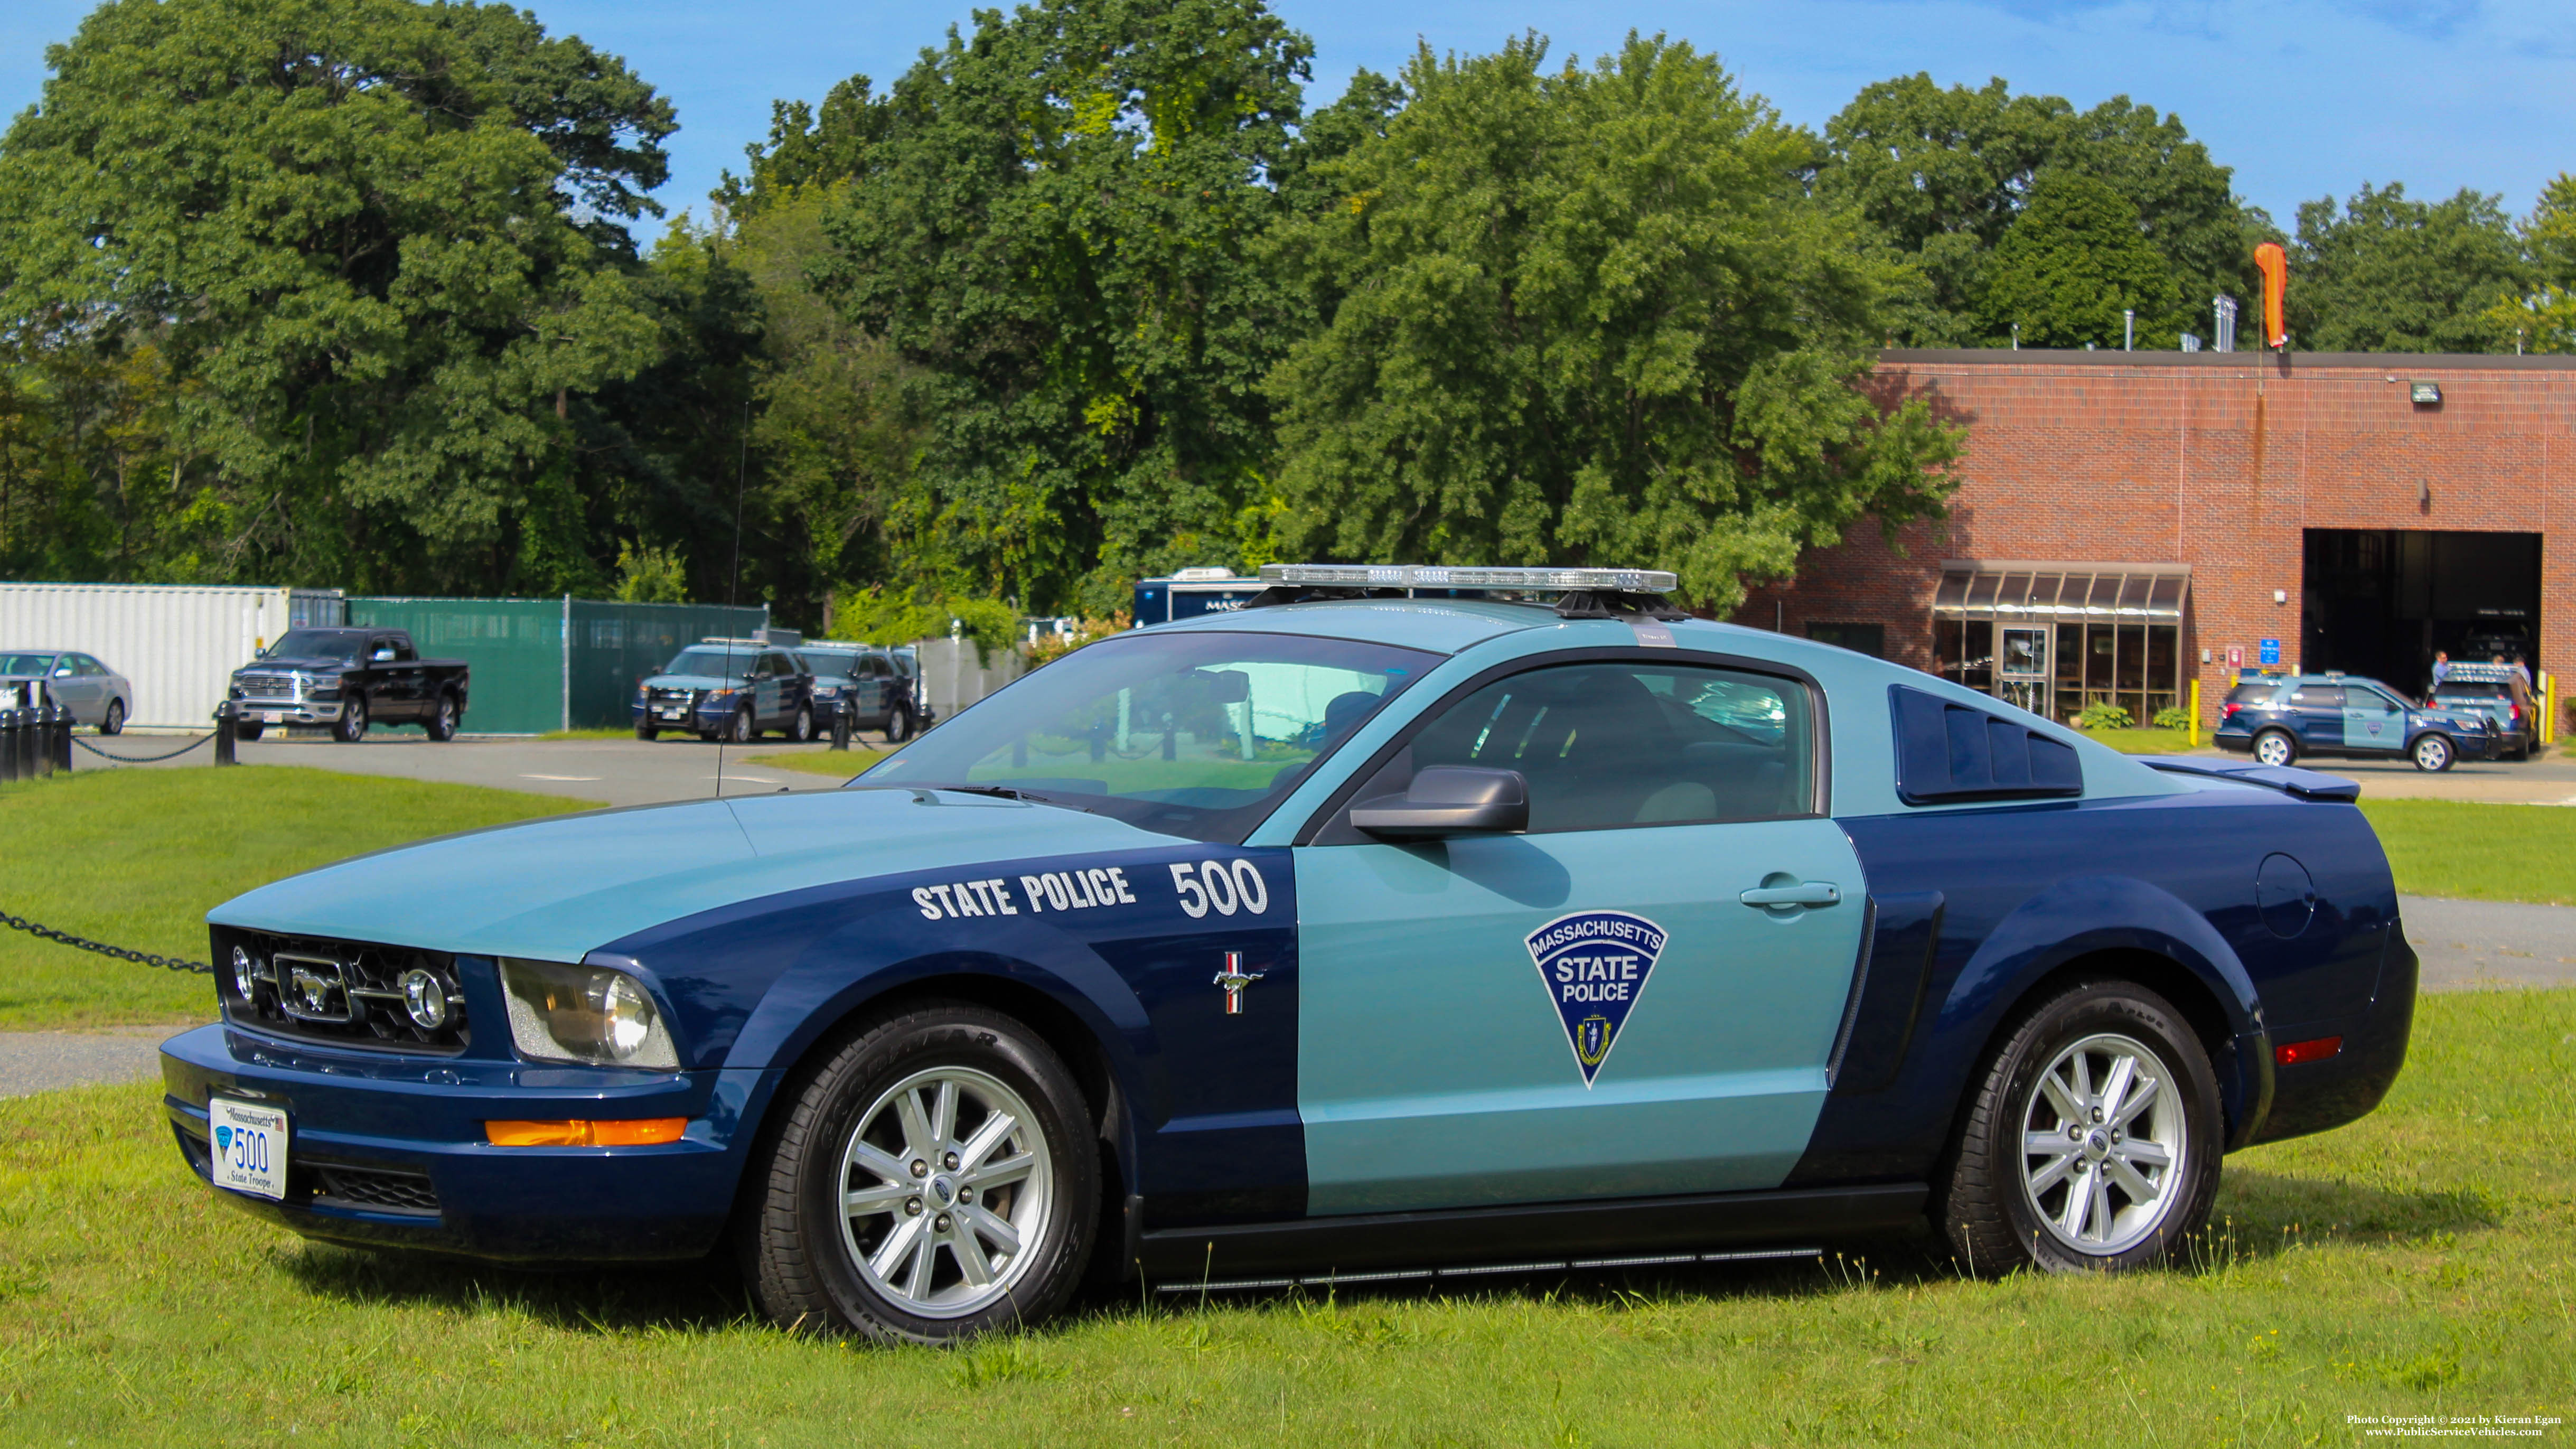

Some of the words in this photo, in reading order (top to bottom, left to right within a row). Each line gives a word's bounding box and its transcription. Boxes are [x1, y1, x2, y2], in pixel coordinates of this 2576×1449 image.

[912, 878, 1018, 920] STATE
[1020, 867, 1136, 913] POLICE
[1169, 859, 1268, 918] 500
[1532, 921, 1662, 957] MASSACHUSETTS
[1556, 956, 1638, 983] STATE
[1563, 983, 1628, 1003] POLICE
[229, 1107, 272, 1128] Massachusetts
[235, 1128, 268, 1173] 500
[231, 1170, 247, 1184] State
[249, 1173, 271, 1188] Trooper
